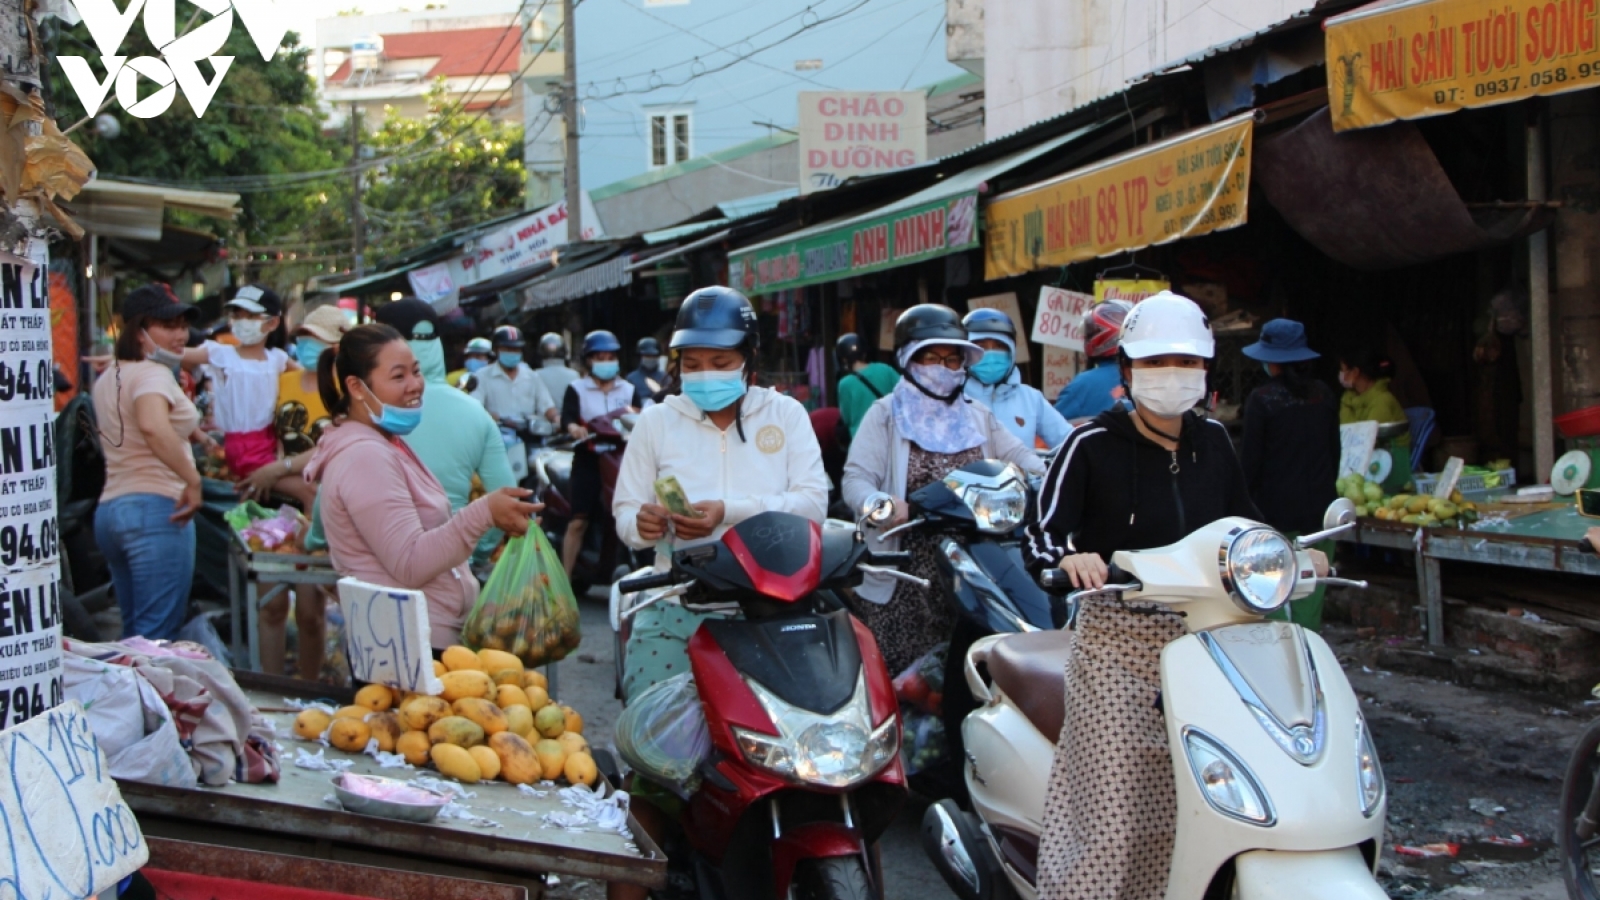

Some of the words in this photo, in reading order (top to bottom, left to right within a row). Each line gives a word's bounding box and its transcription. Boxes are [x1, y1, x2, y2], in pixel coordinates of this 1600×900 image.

[1369, 25, 1405, 92] HẢI
[1411, 15, 1455, 86] SẢN
[818, 93, 904, 117] CHÁO
[824, 122, 900, 142] DINH
[1096, 183, 1118, 246] 88
[1123, 175, 1149, 238] VP
[852, 224, 890, 268] ANH
[892, 207, 947, 260] MINH
[780, 623, 817, 632] HONDA
